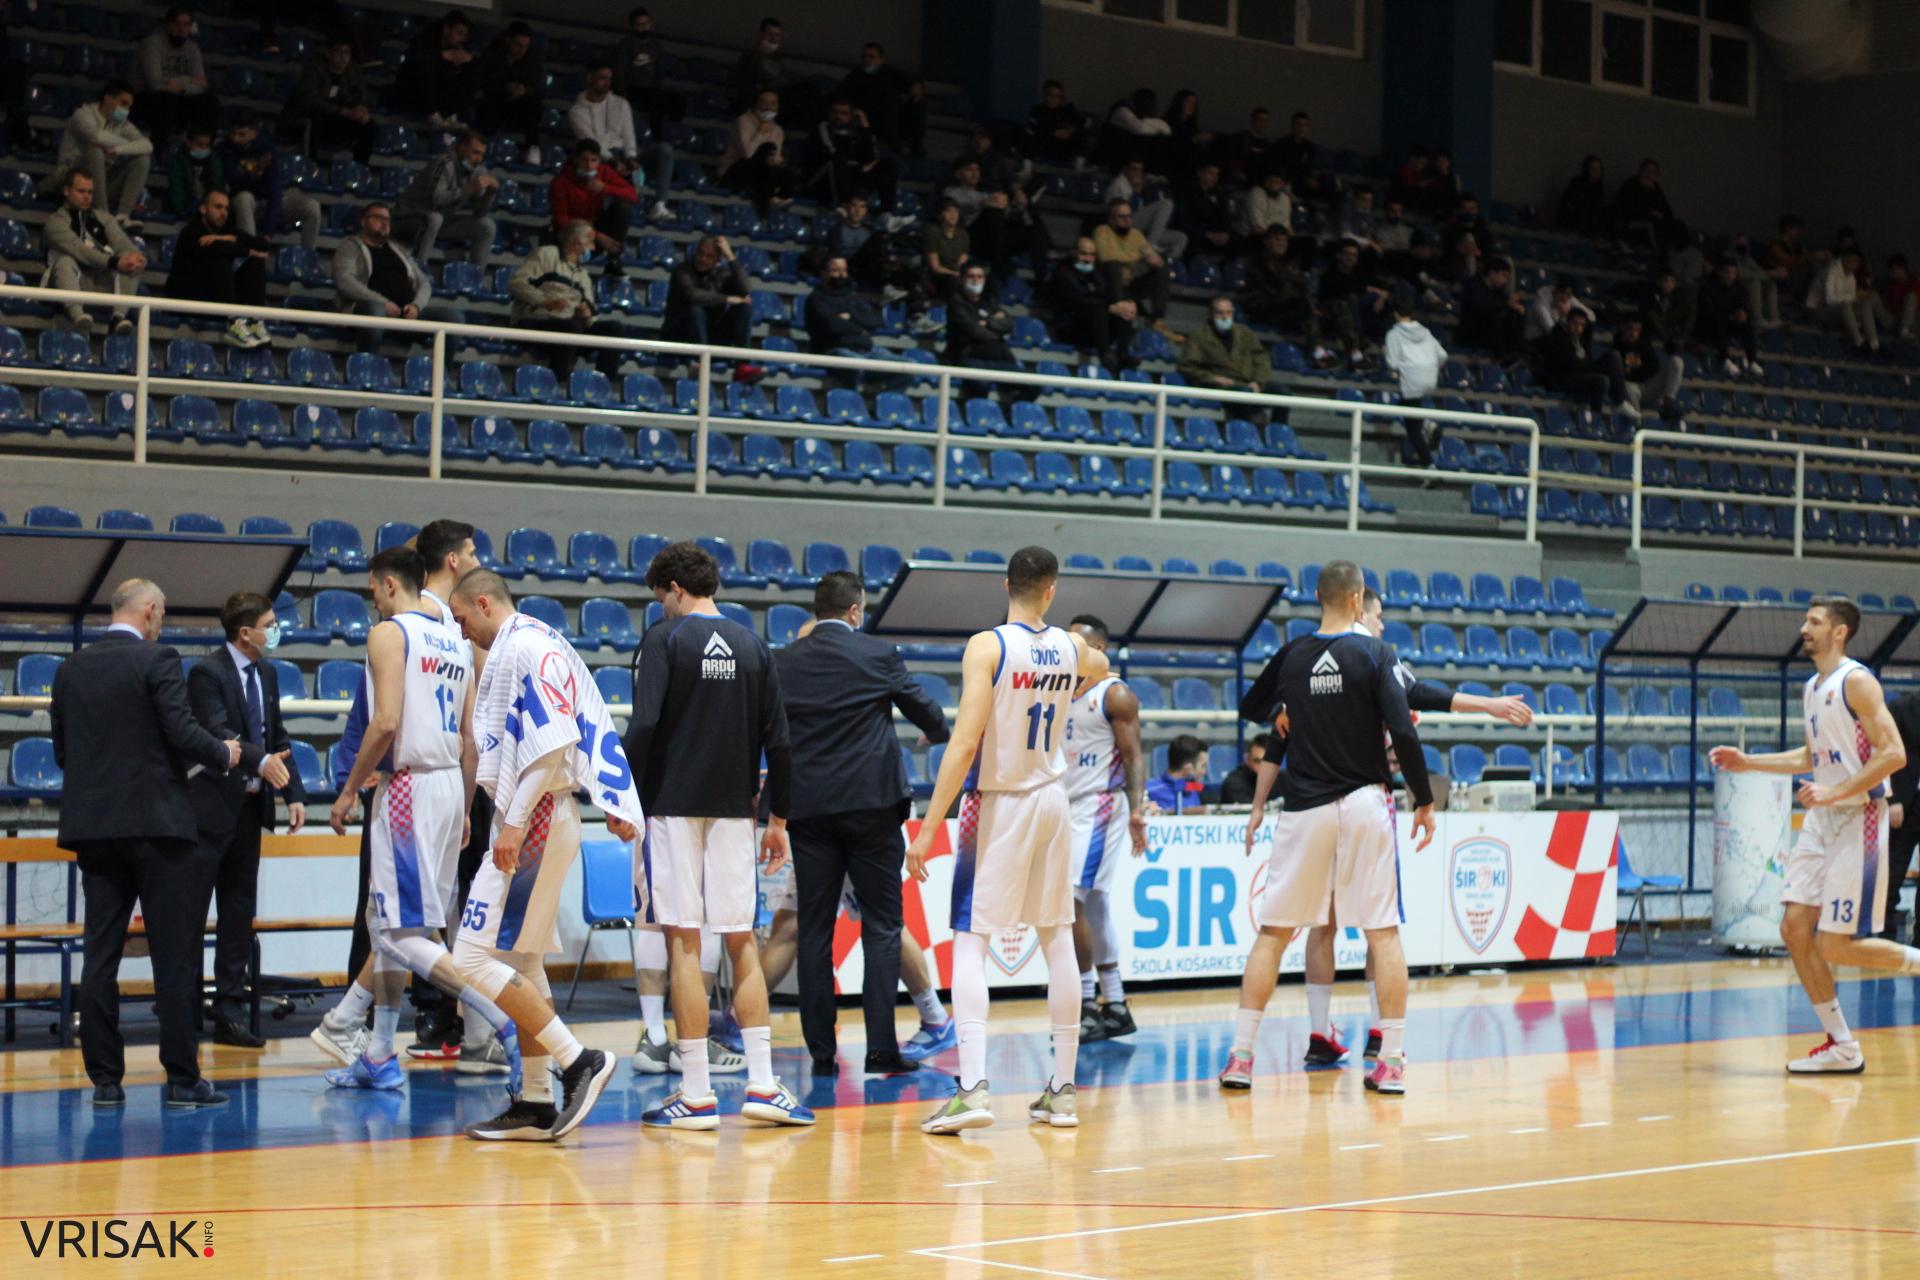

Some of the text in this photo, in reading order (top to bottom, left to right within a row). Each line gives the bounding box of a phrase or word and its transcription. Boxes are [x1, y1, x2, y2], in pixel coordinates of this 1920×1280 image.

[702, 659, 736, 672] ARDU
[1310, 674, 1342, 688] ARDU
[1027, 702, 1055, 752] 11
[1147, 825, 1221, 846] RVATSKI
[462, 898, 488, 931] 55
[1831, 898, 1853, 923] 13
